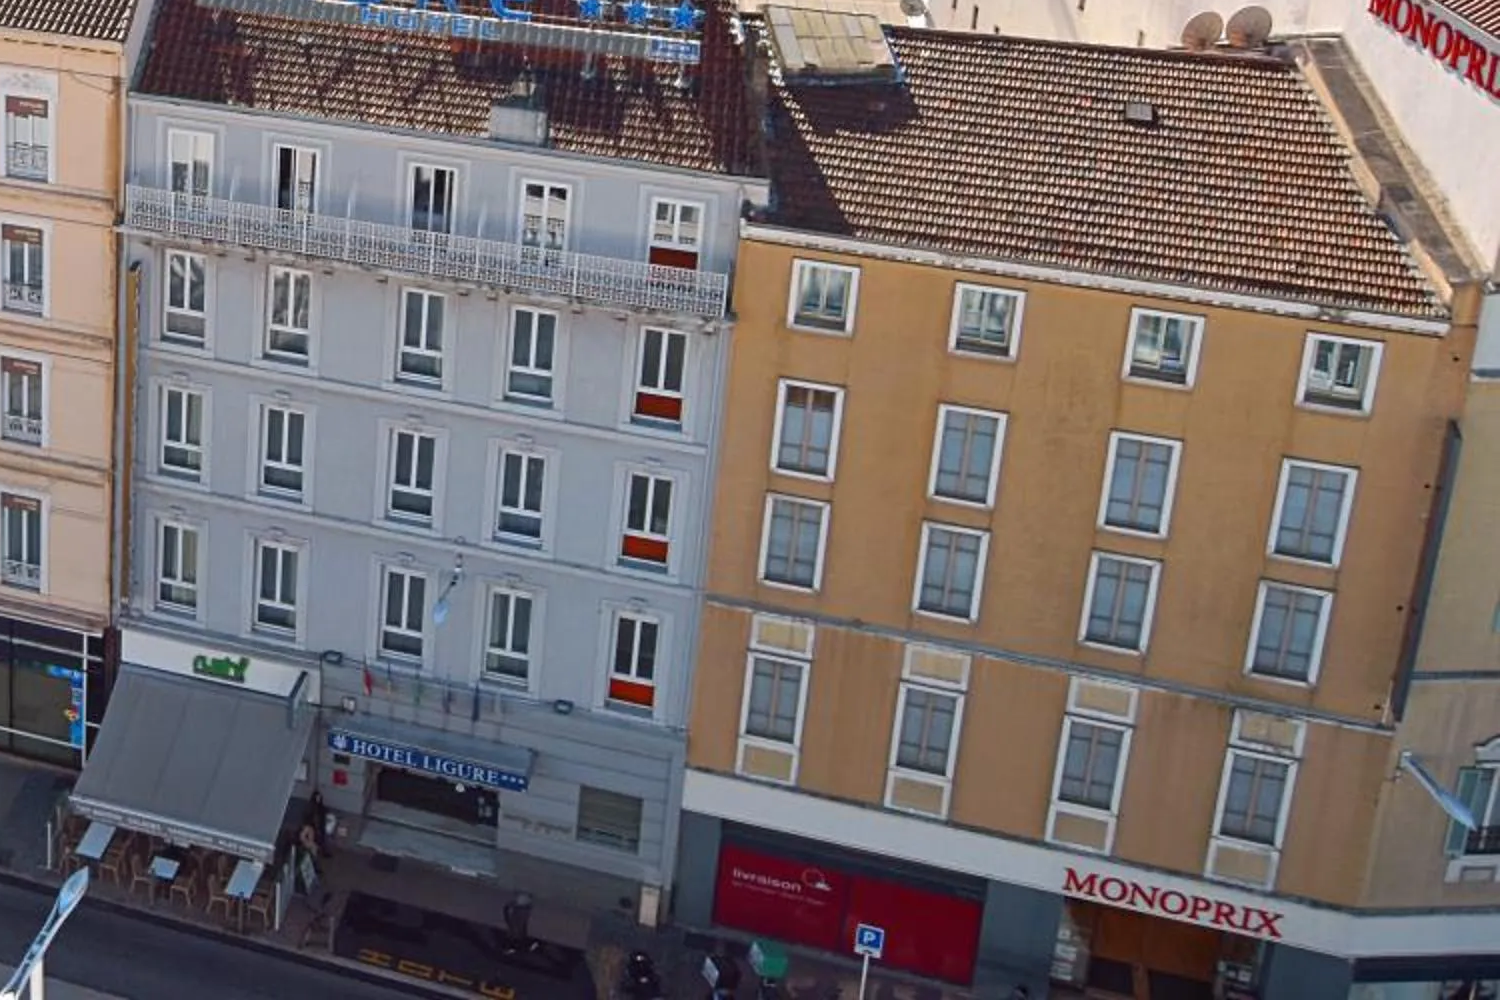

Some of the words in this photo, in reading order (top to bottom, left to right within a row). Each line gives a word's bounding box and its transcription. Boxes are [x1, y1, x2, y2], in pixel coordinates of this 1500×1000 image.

[361, 4, 502, 39] HOTEL
[353, 739, 417, 767] HOTEL
[423, 756, 499, 785] LIGURE
[1063, 867, 1284, 939] MONOPRIX
